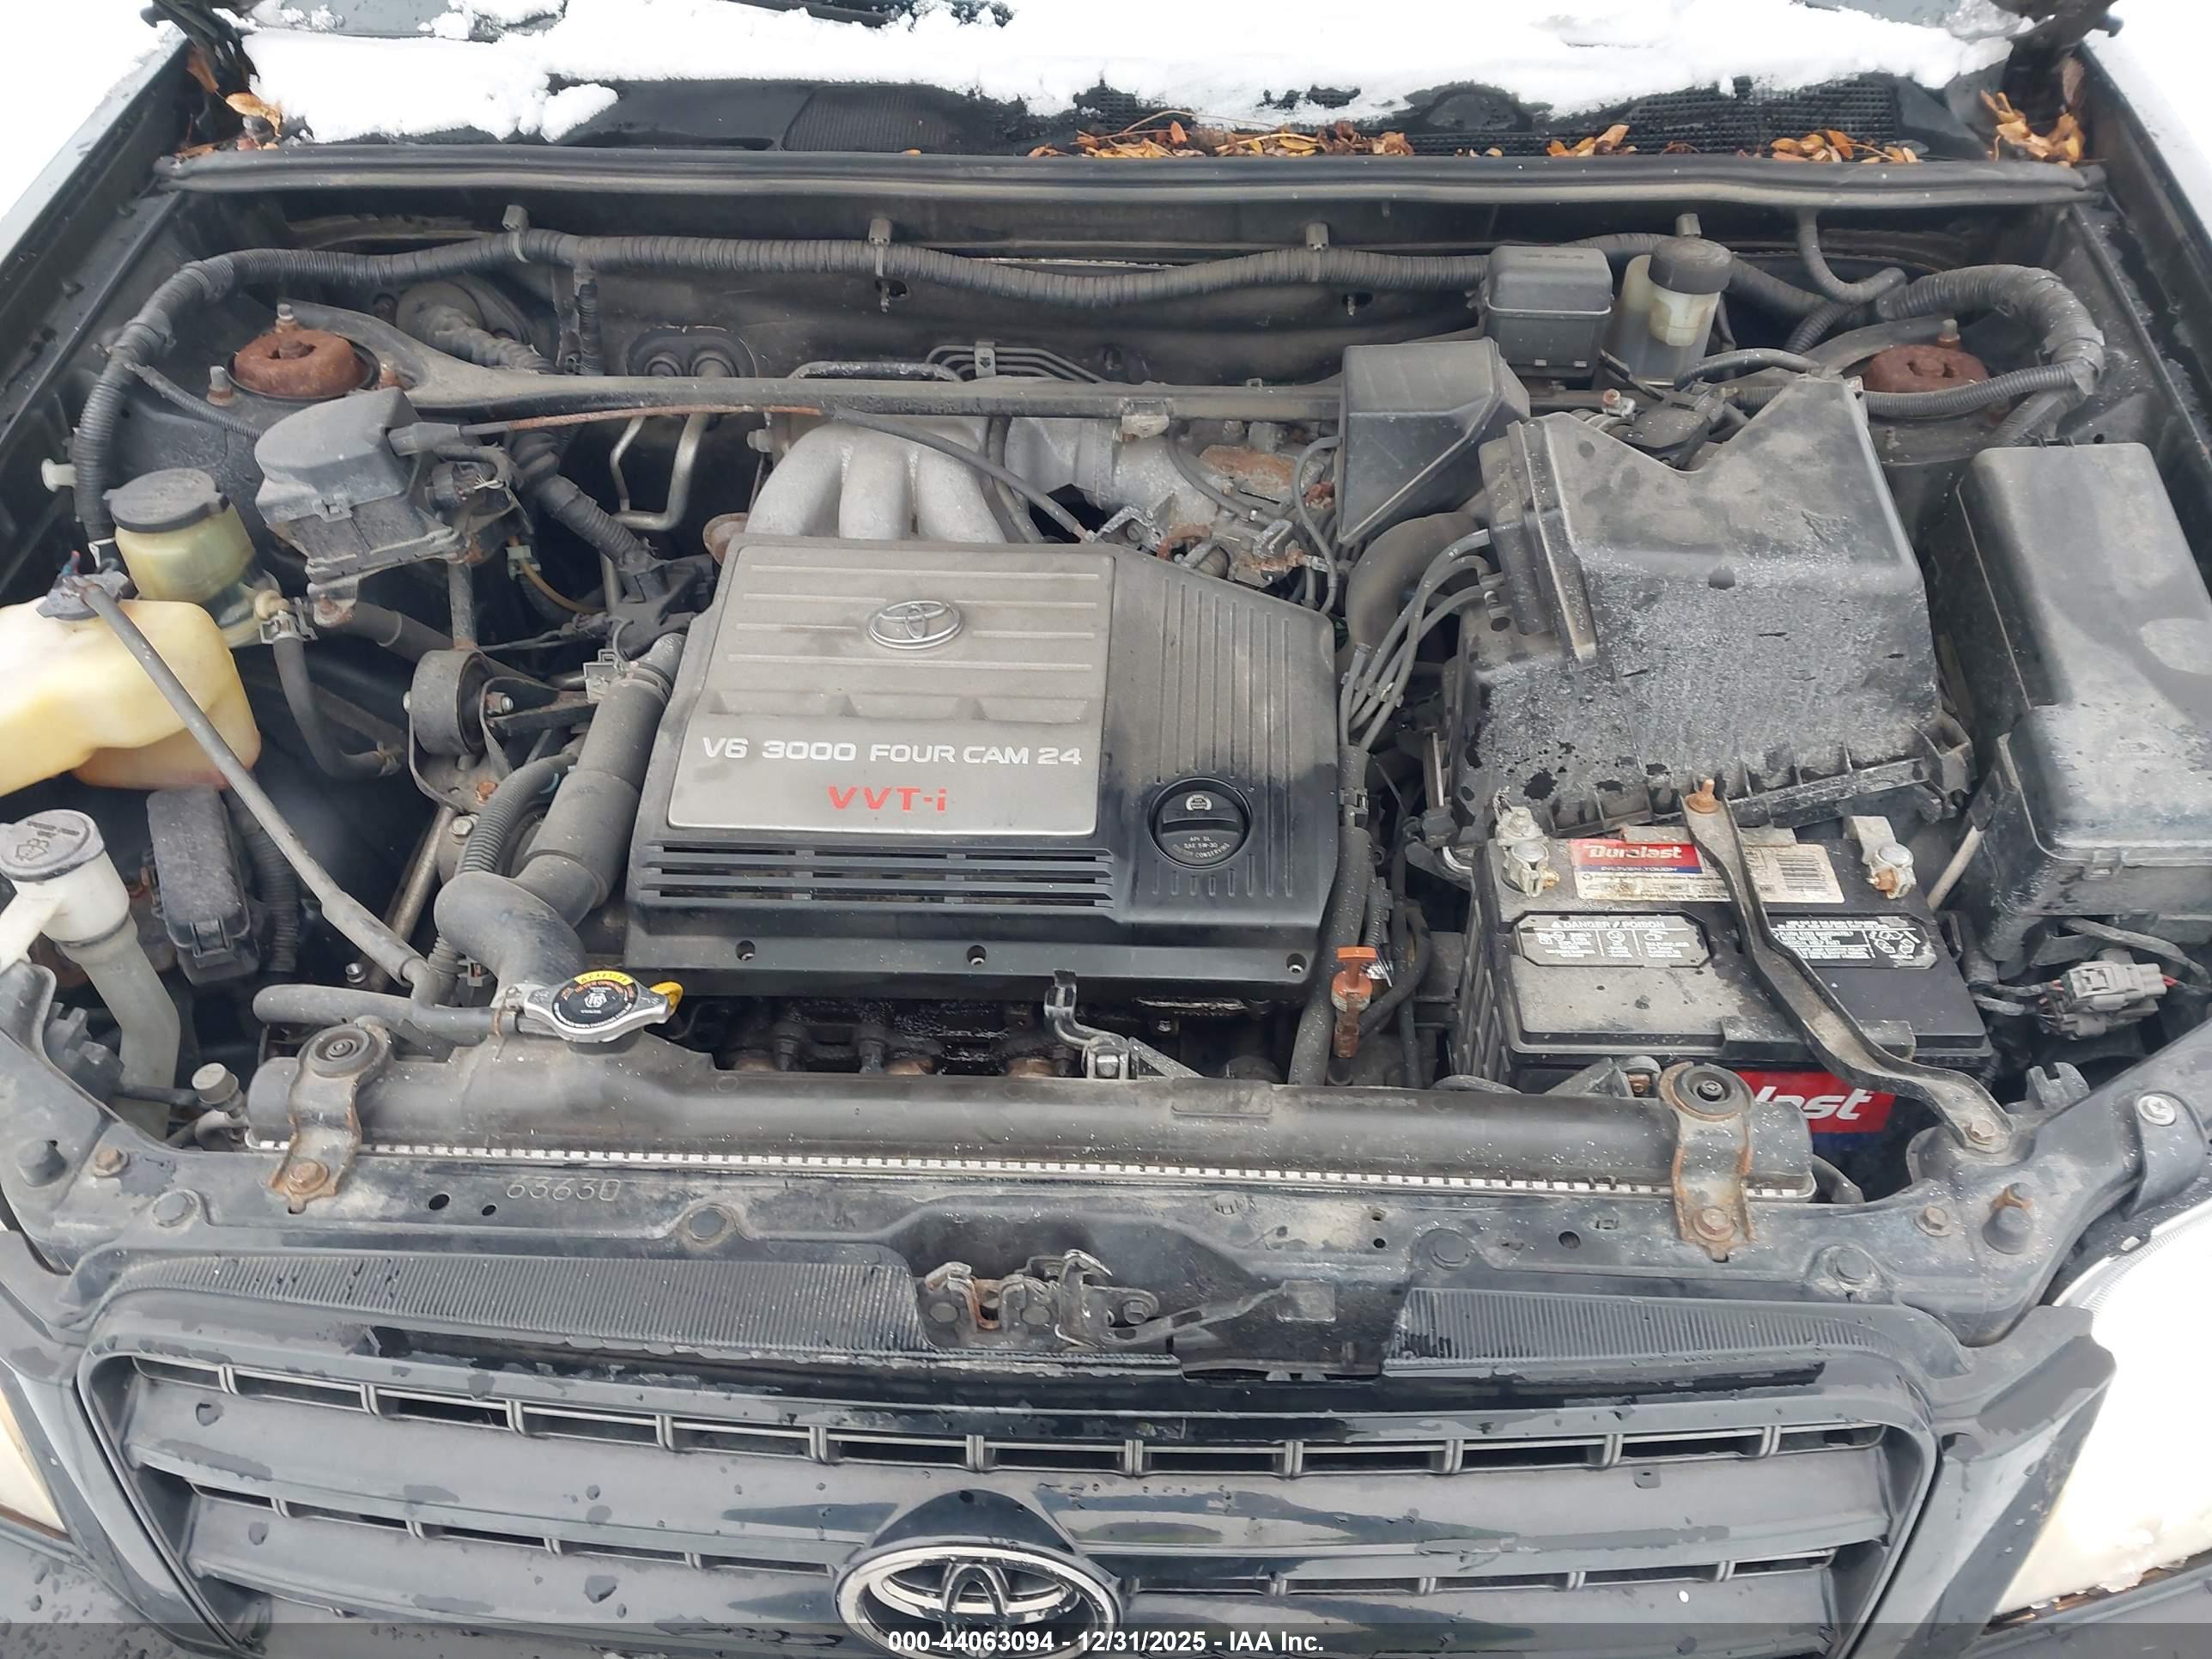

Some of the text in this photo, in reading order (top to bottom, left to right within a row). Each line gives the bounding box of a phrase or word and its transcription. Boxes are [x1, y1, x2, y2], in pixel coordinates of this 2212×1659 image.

[702, 737, 1083, 765] V6 3000 FOUR CAM 24
[828, 786, 947, 811] VVT-i
[1583, 844, 1682, 859] Duralast
[506, 1176, 622, 1202] 63630
